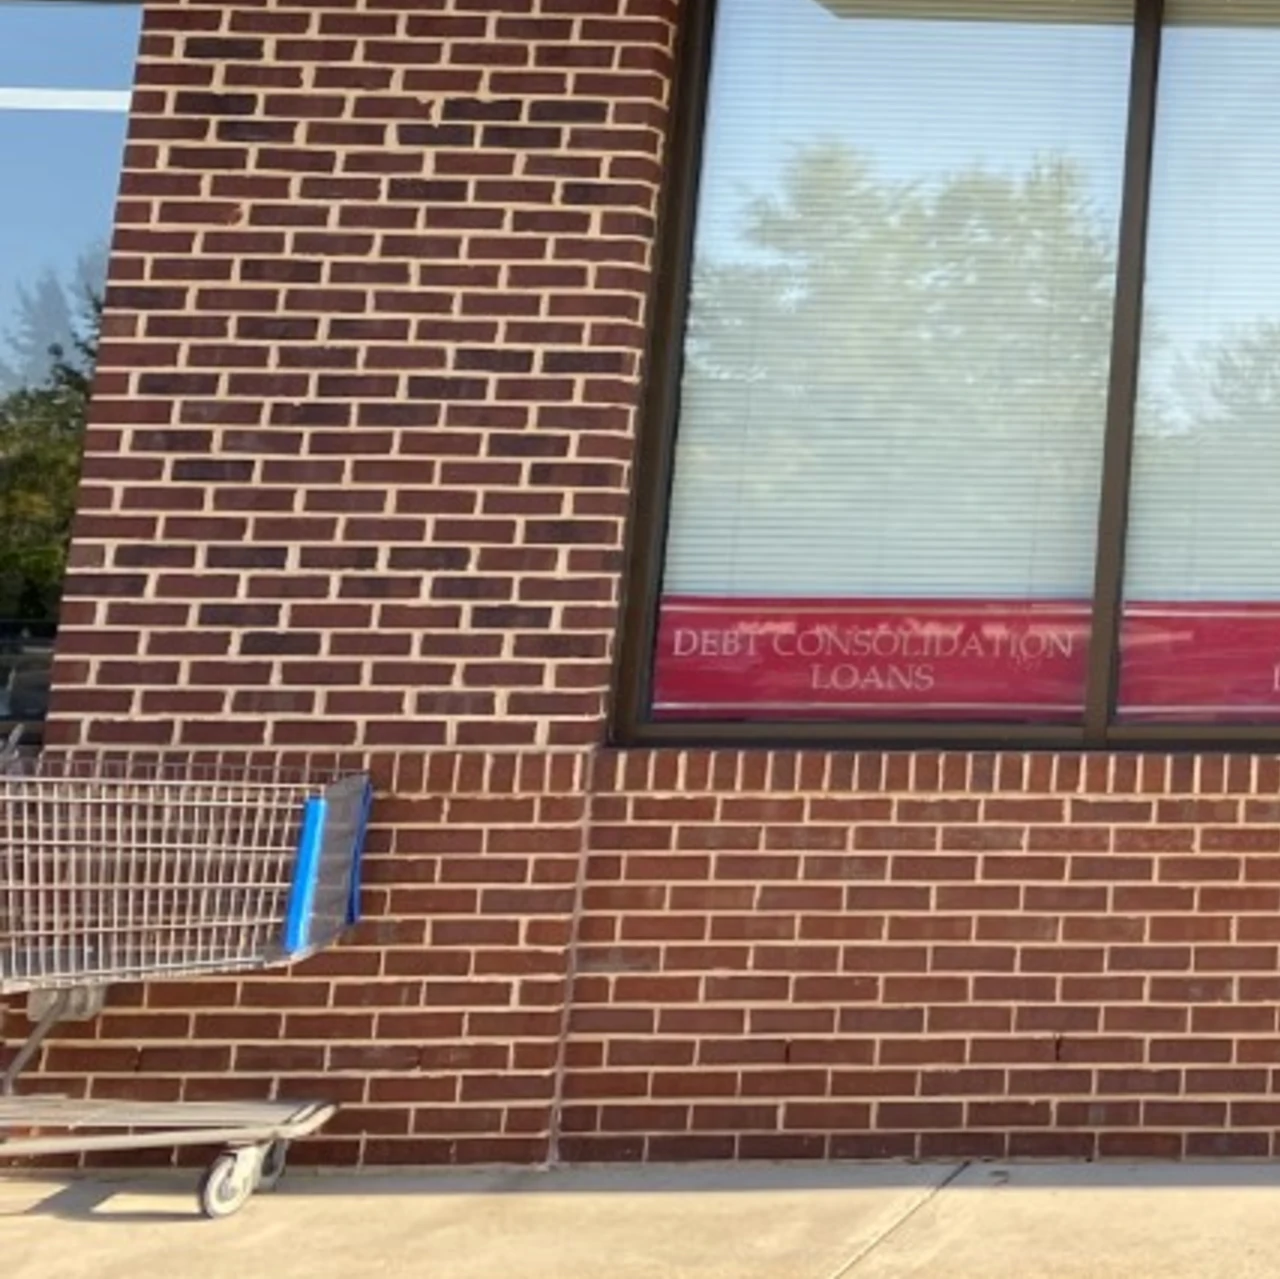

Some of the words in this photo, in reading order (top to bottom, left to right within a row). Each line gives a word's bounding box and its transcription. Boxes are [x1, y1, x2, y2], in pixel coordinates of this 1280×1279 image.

[672, 628, 760, 657] DEBT
[772, 628, 1073, 659] CONSOLIDATION
[811, 663, 935, 692] LOANS
